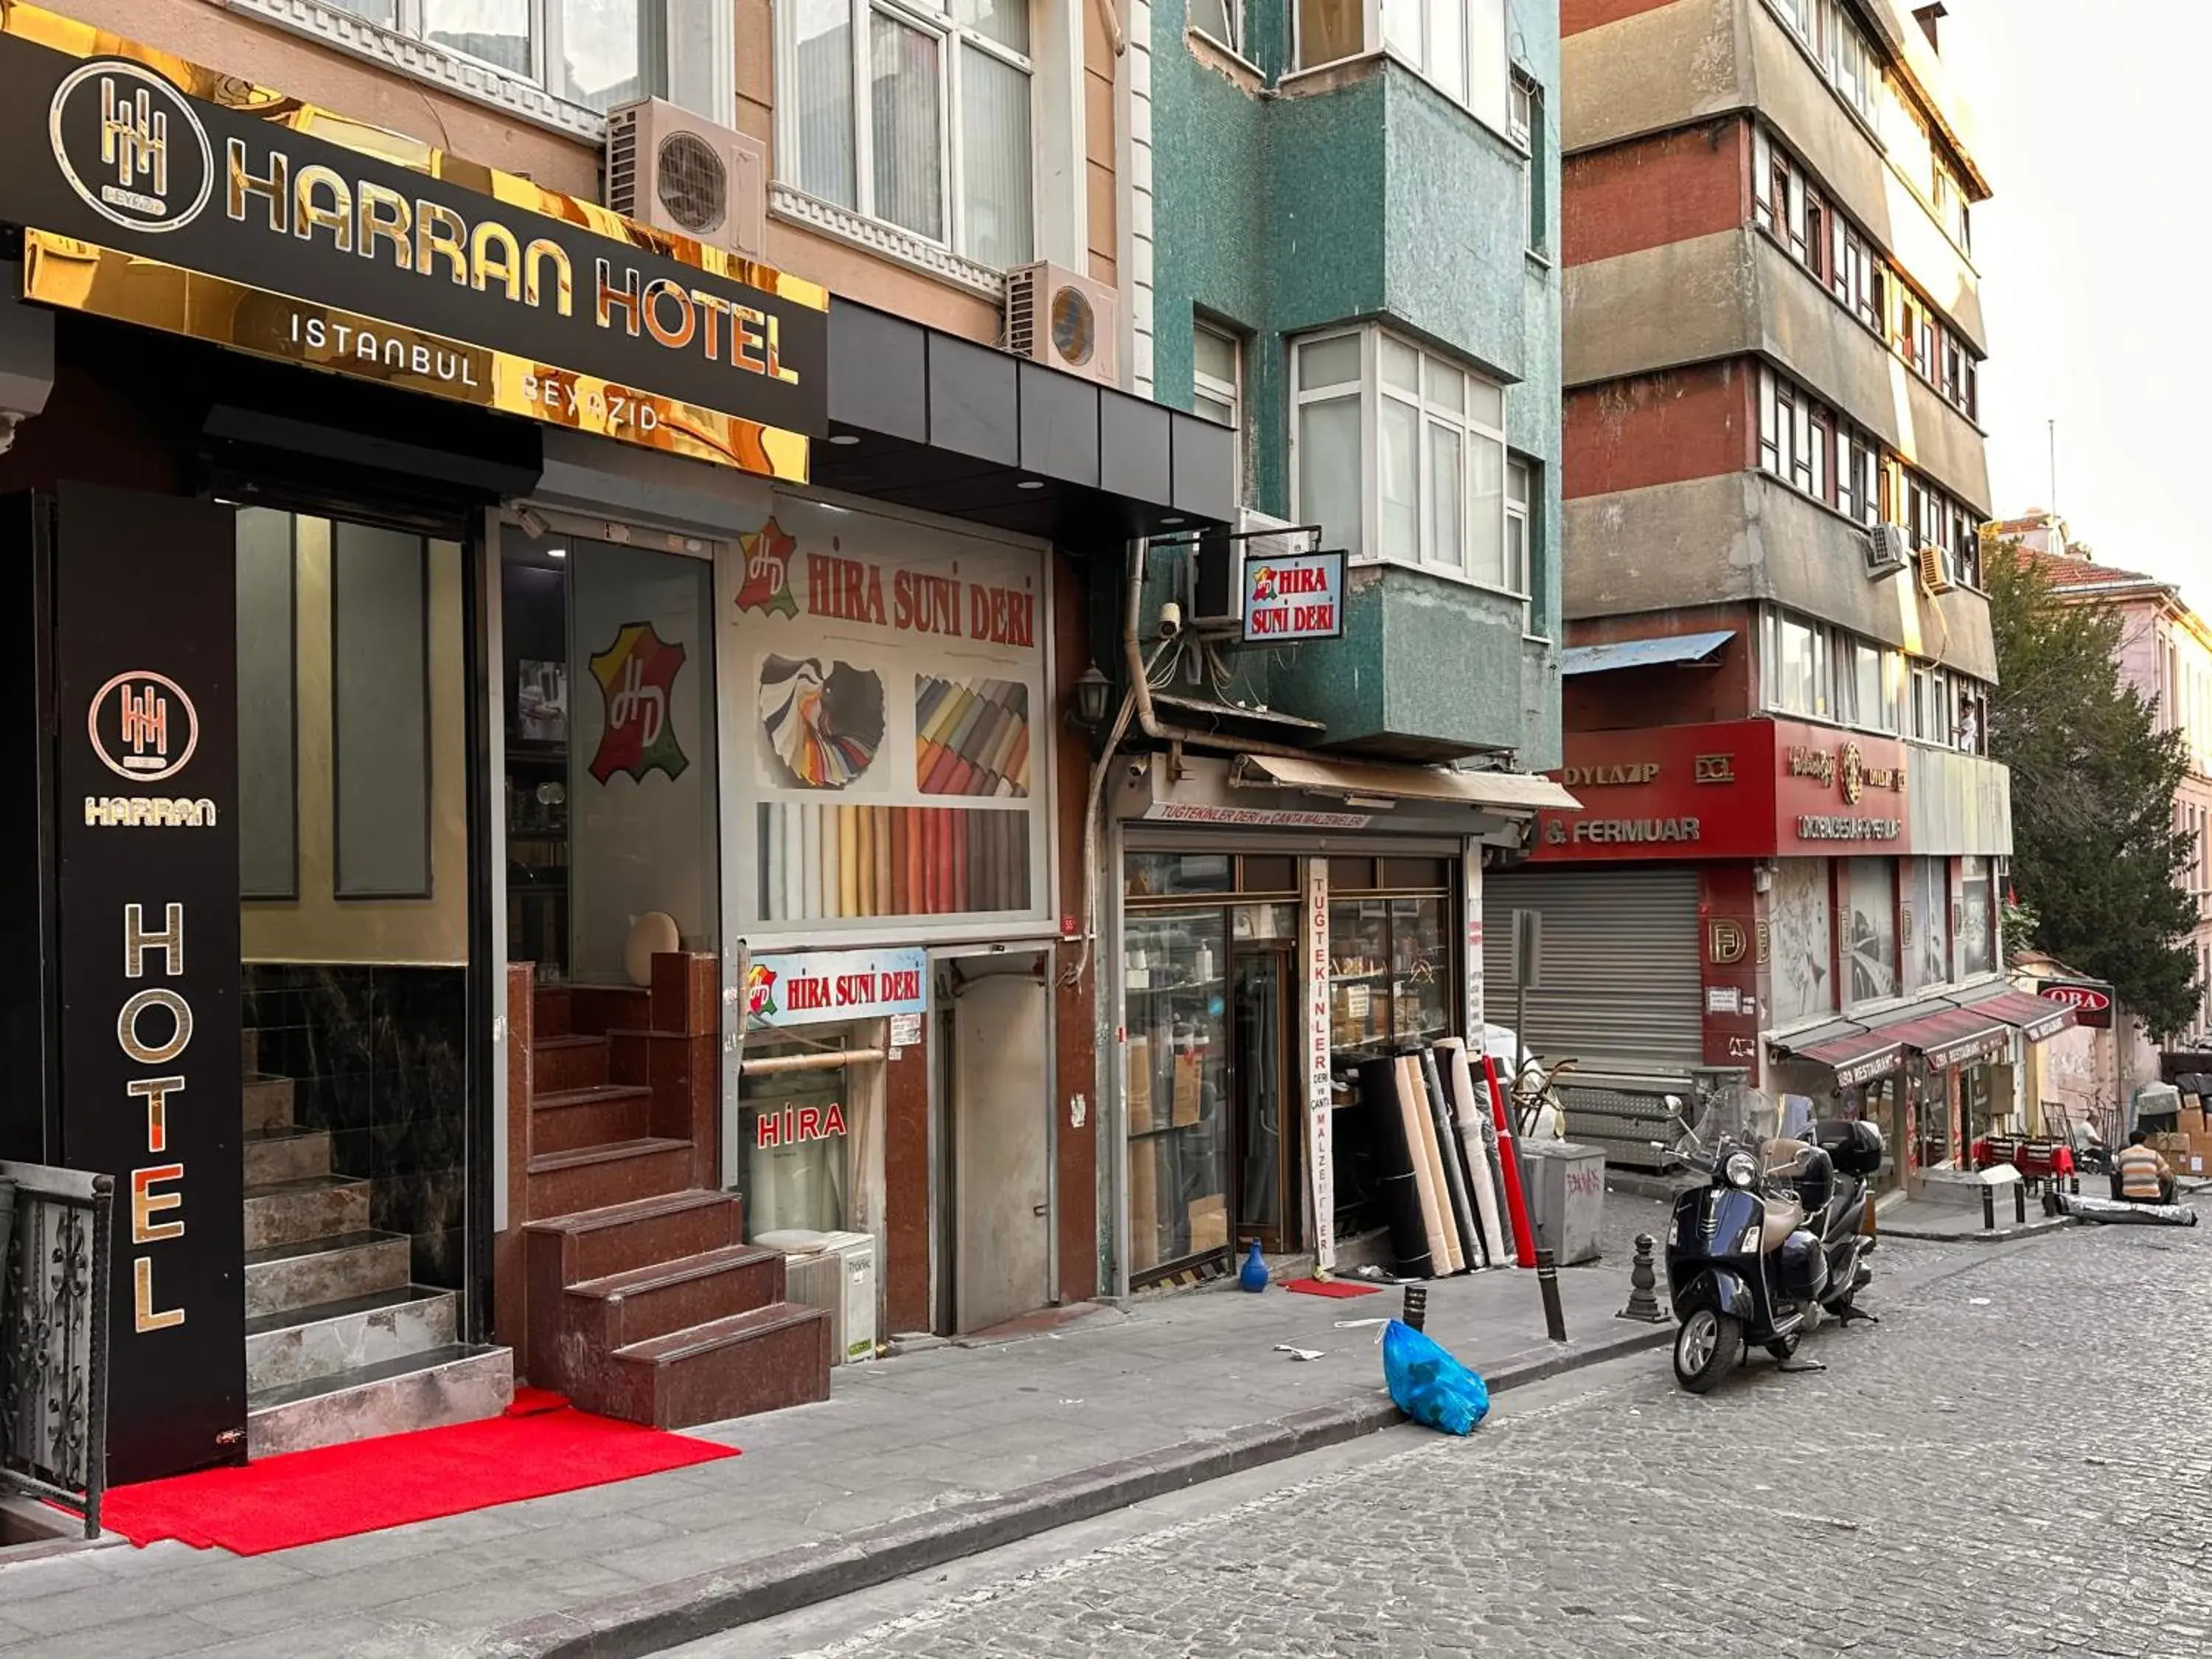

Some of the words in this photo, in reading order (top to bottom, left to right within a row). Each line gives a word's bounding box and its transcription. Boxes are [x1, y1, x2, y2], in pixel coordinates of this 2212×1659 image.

[226, 136, 573, 317] HARRAN
[595, 257, 799, 386] HOTEL
[291, 313, 479, 386] ISTANBUL
[522, 375, 658, 431] BEYAZID
[85, 796, 216, 827] HARRAN
[1545, 818, 1567, 844] &
[1573, 816, 1700, 844] FERMUAR
[2050, 990, 2097, 1008] OBA
[117, 902, 193, 1334] HOTEL
[757, 1102, 847, 1150] HİRA
